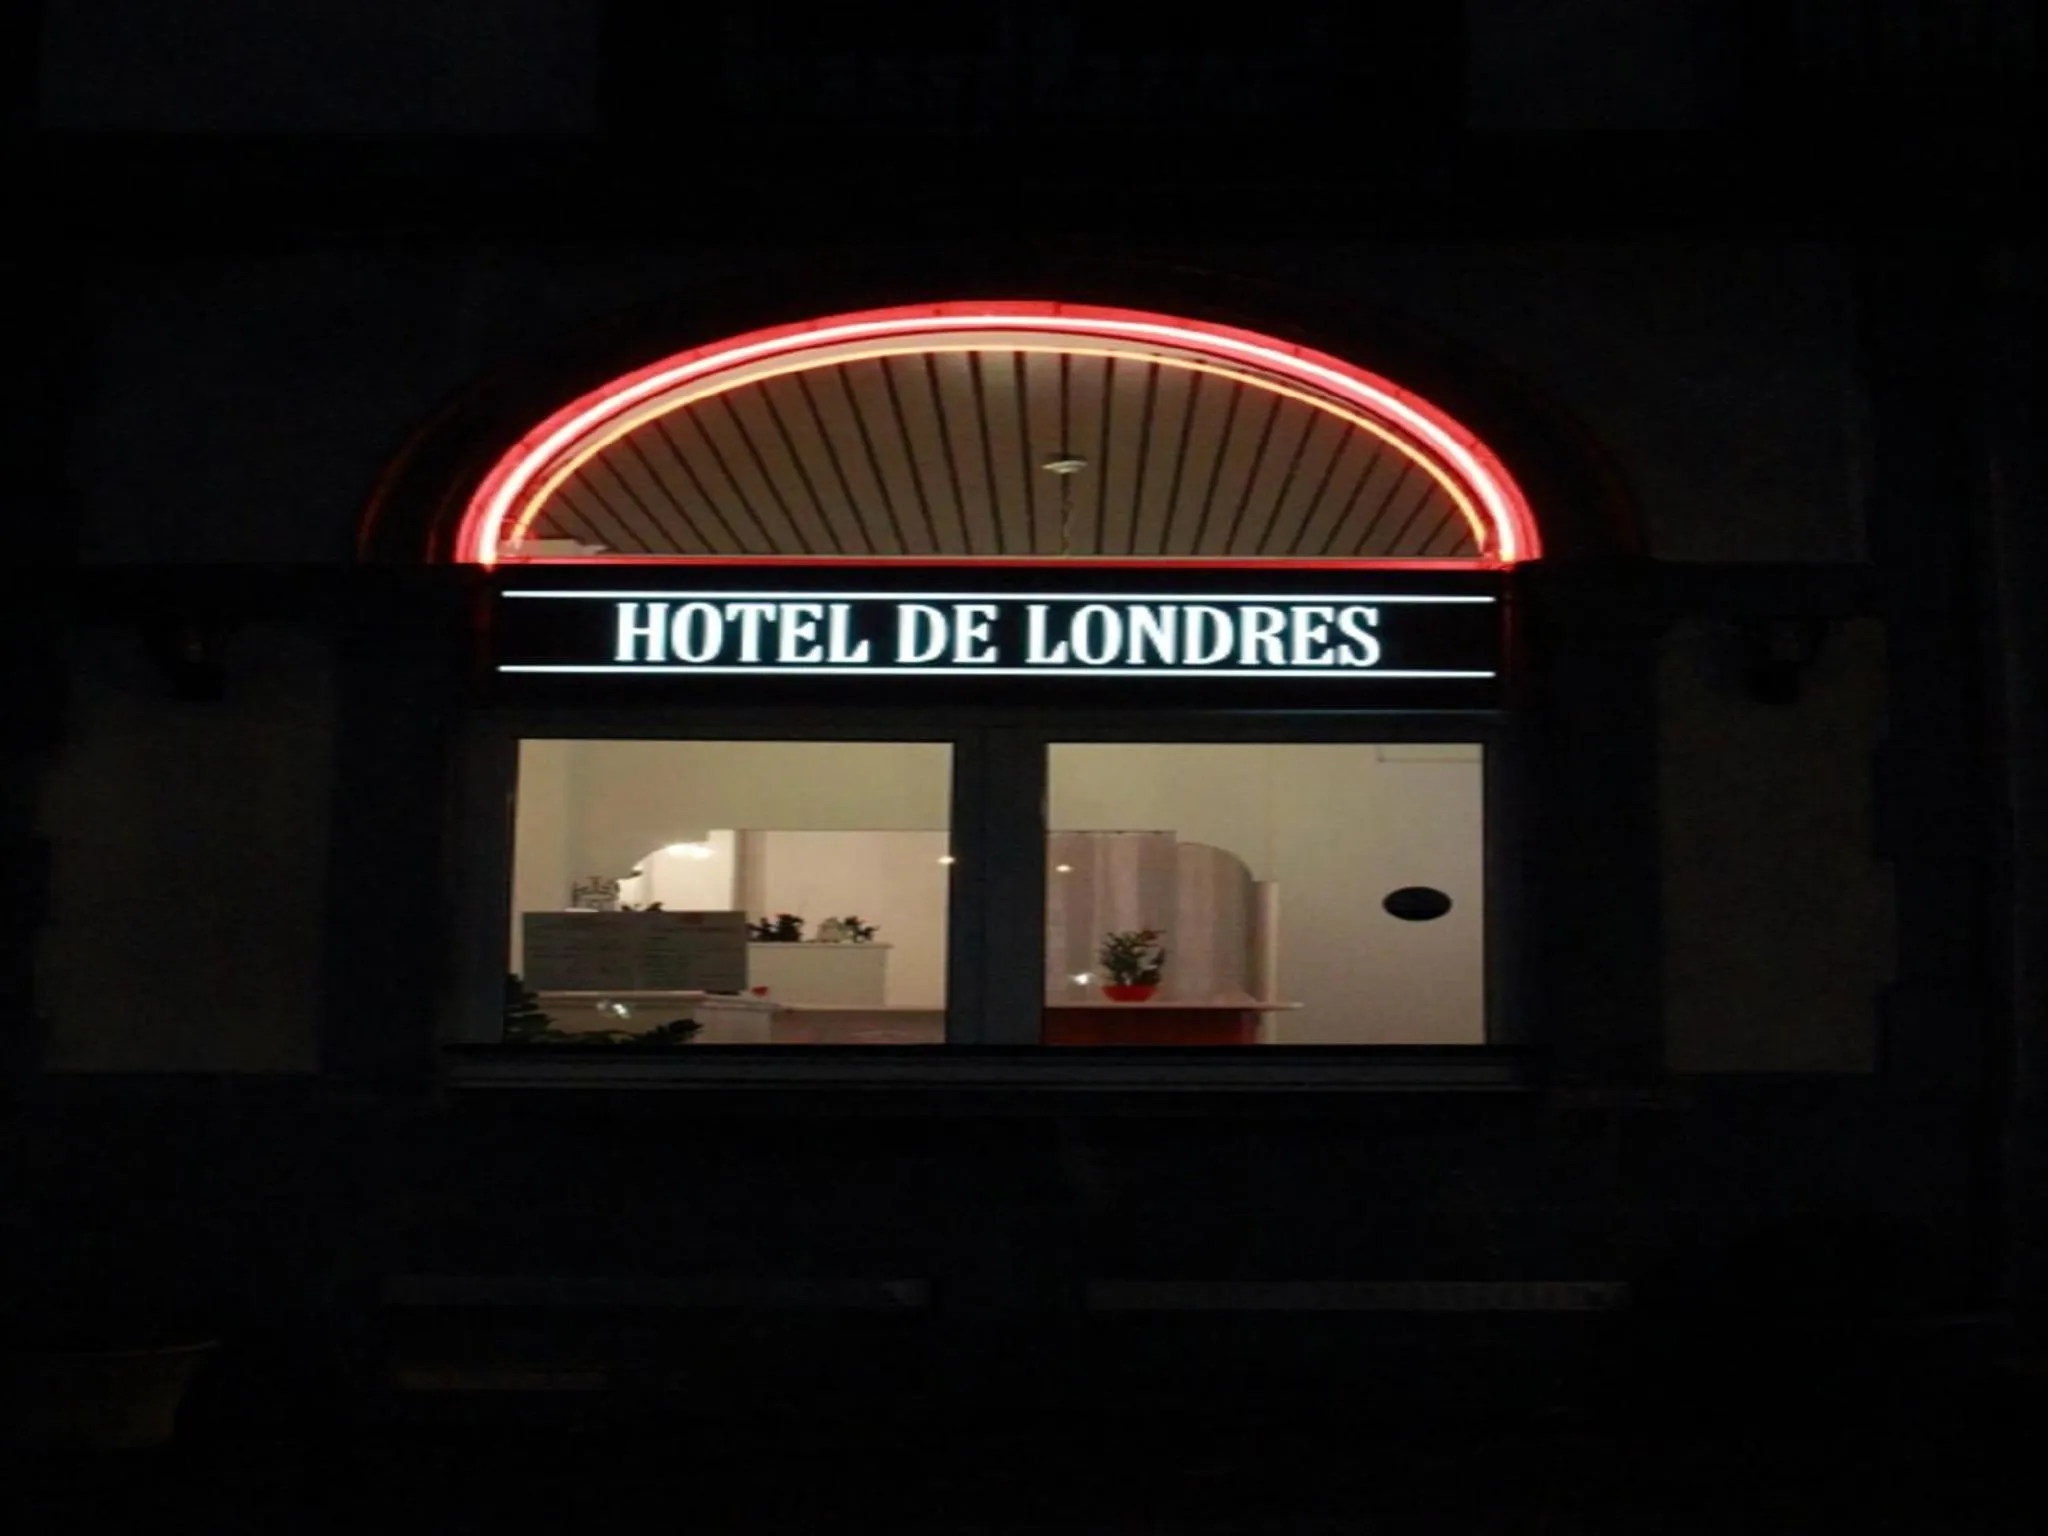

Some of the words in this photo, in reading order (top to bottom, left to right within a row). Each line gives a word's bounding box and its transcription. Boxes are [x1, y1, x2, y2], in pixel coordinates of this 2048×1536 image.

[614, 602, 869, 663] HOTEL
[895, 603, 998, 664] DE
[1025, 604, 1381, 667] LONDRES
